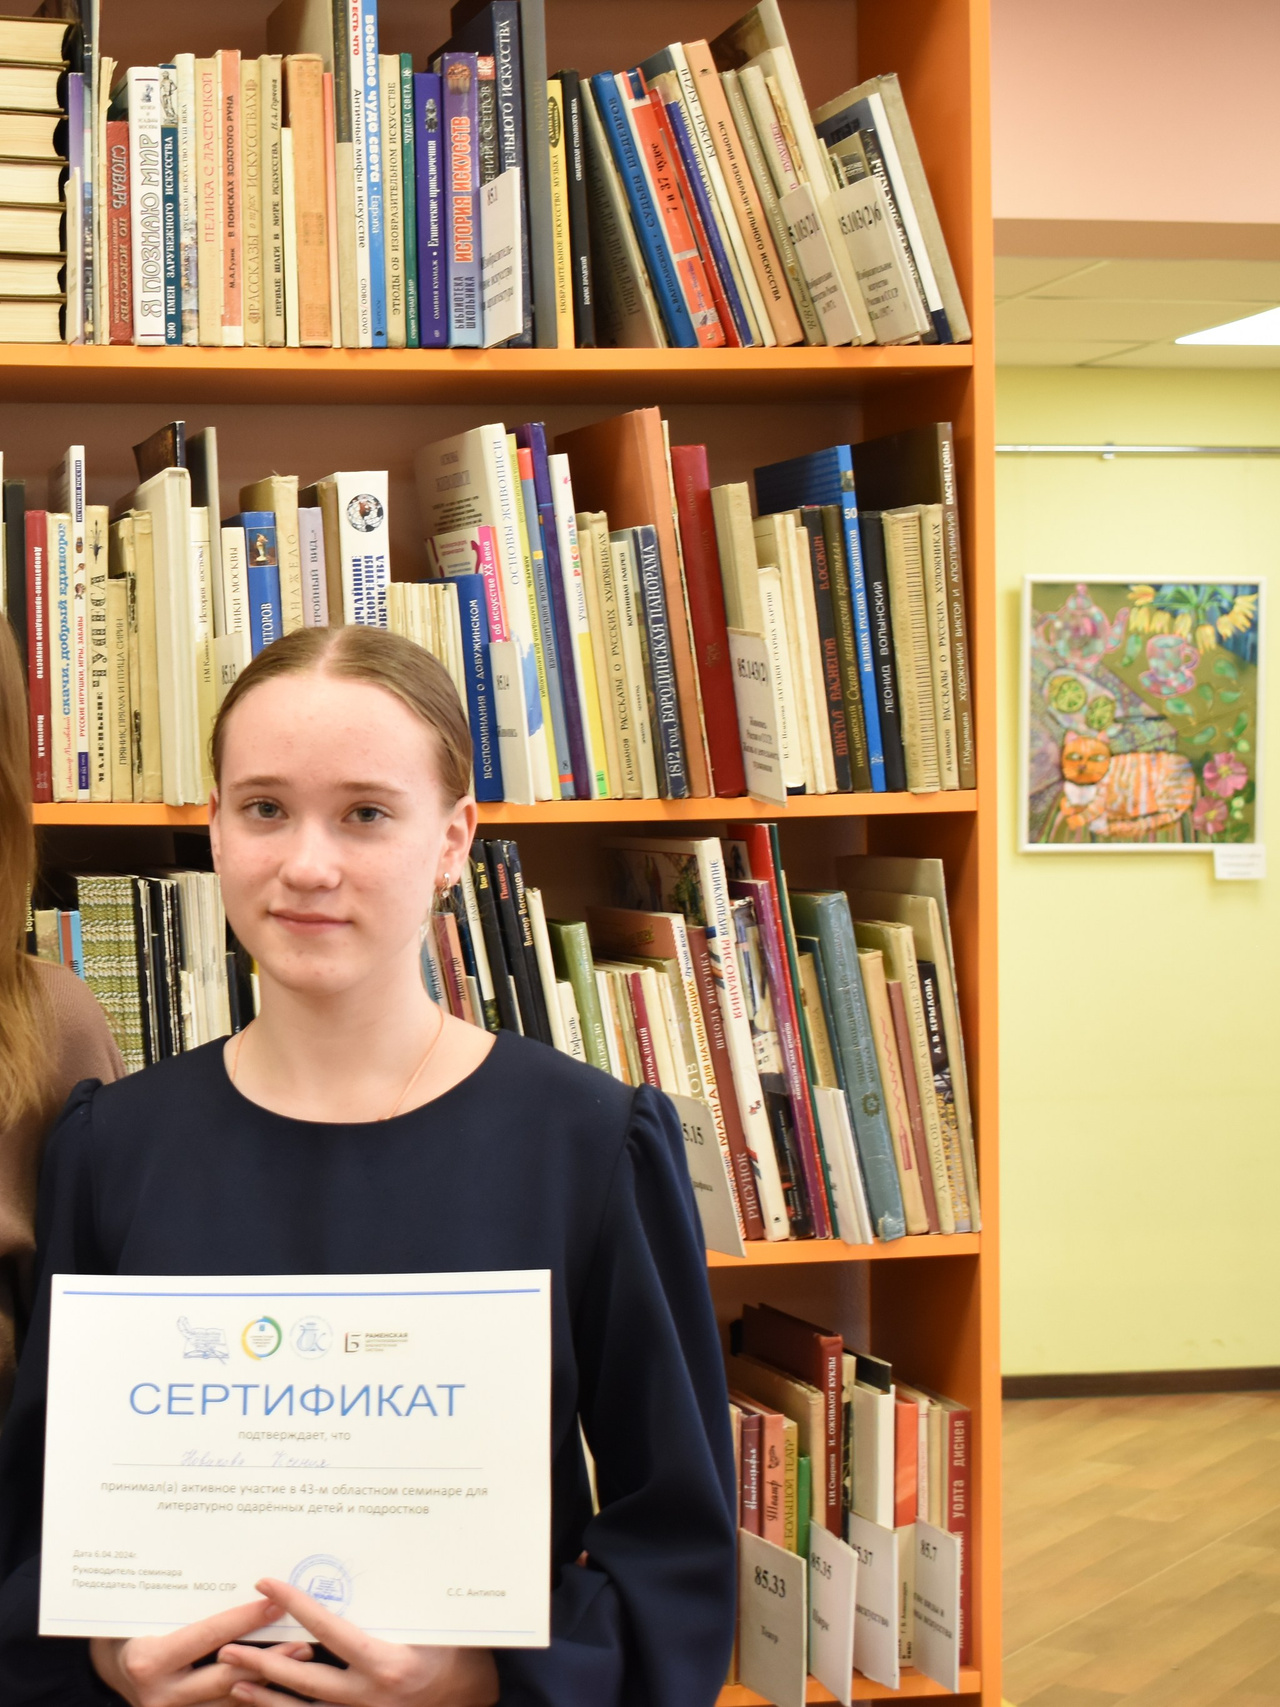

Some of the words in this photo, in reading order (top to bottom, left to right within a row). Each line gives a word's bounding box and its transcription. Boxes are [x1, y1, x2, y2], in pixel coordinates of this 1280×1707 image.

[353, 89, 363, 145] Античные
[387, 82, 397, 144] ИСКУССТВЕ
[139, 133, 159, 186] МИР
[163, 136, 174, 195] ИСКУССТВА
[353, 149, 365, 183] мифы
[451, 117, 471, 191] ИСКУССТВ
[388, 149, 399, 252] ИЗОБРАЗИТЕЛЬНОМ
[717, 121, 736, 161] ИСТОРИЯ
[731, 163, 764, 250] ИЗОБРАЗИТЕЛЬНОГО
[760, 253, 781, 301] ИСКУССТВА
[165, 203, 175, 278] ЗАРУБЕЖНОГО
[356, 196, 367, 248] искусстве
[454, 197, 473, 262] ИСТОРИЯ
[140, 192, 161, 293] ПОЗНАЮ
[390, 257, 400, 270] ОБ
[140, 300, 163, 318] Я
[166, 286, 175, 315] ИМЕН
[390, 275, 402, 315] ЭТЮДЫ
[454, 276, 465, 329] БИБЛИОТЕКА
[466, 276, 476, 329] ШКОЛЬНИКА
[166, 322, 175, 338] 300
[942, 441, 954, 504] ВАСНЕЦОВЫ
[844, 508, 858, 519] 50
[849, 529, 864, 589] ХУДОЖНИКОВ
[945, 512, 959, 582] АПОЛЛИНАРИЙ
[856, 591, 867, 629] РУССКИХ
[953, 589, 960, 597] И
[873, 581, 889, 655] ВОЛЫНСКИЙ
[952, 602, 963, 637] ВИКТОР
[470, 599, 484, 679] ДОБУЖИНСКОМ
[861, 631, 871, 671] ВЕЛИКИХ
[77, 668, 86, 703] ИГРУШКИ,
[476, 683, 485, 691] О
[881, 664, 894, 713] ЛЕОНИД
[956, 642, 967, 701] ХУДОЖНИКИ
[478, 696, 493, 779] ВОСПОМИНАНИЯ
[477, 862, 485, 872] Гог
[479, 875, 488, 889] Ван
[497, 863, 508, 900] Пикассо
[514, 872, 526, 915] Васнецов
[522, 917, 533, 946] Виктор
[710, 859, 729, 936] ЭНЦИКЛОПЕДИЯ
[721, 940, 742, 1019] РИСОВАНИЯ
[923, 978, 938, 1032] КРЫЛОВА
[568, 1017, 581, 1055] Рафаэль
[931, 1033, 940, 1042] В.
[933, 1043, 942, 1054] А.
[129, 1382, 465, 1417] СЕРТИФИКАТ
[238, 1429, 327, 1441] подтверждает,
[331, 1430, 351, 1439] что
[101, 1481, 178, 1494] принимал(а)
[181, 1482, 237, 1493] активное
[241, 1483, 286, 1495] участие
[290, 1484, 296, 1493] в
[300, 1484, 328, 1495] 43-м
[332, 1484, 398, 1496] областном
[402, 1486, 462, 1499] семинаре
[466, 1487, 488, 1498] для
[157, 1500, 233, 1514] литературно
[237, 1500, 304, 1514] одарённых
[308, 1502, 343, 1515] детей
[347, 1505, 354, 1513] и
[359, 1503, 429, 1516] подростков
[785, 1479, 794, 1538] БОЛЬШОЙ
[73, 1549, 92, 1559] Дата
[73, 1565, 135, 1576] Руководитель
[138, 1567, 182, 1577] семинара
[73, 1580, 137, 1591] Председатель
[139, 1581, 188, 1591] Правления
[193, 1582, 216, 1591] МОО
[219, 1582, 237, 1592] СПР
[447, 1588, 464, 1596] С.С.
[467, 1588, 506, 1598] Антипов
[754, 1565, 787, 1598] 85.33
